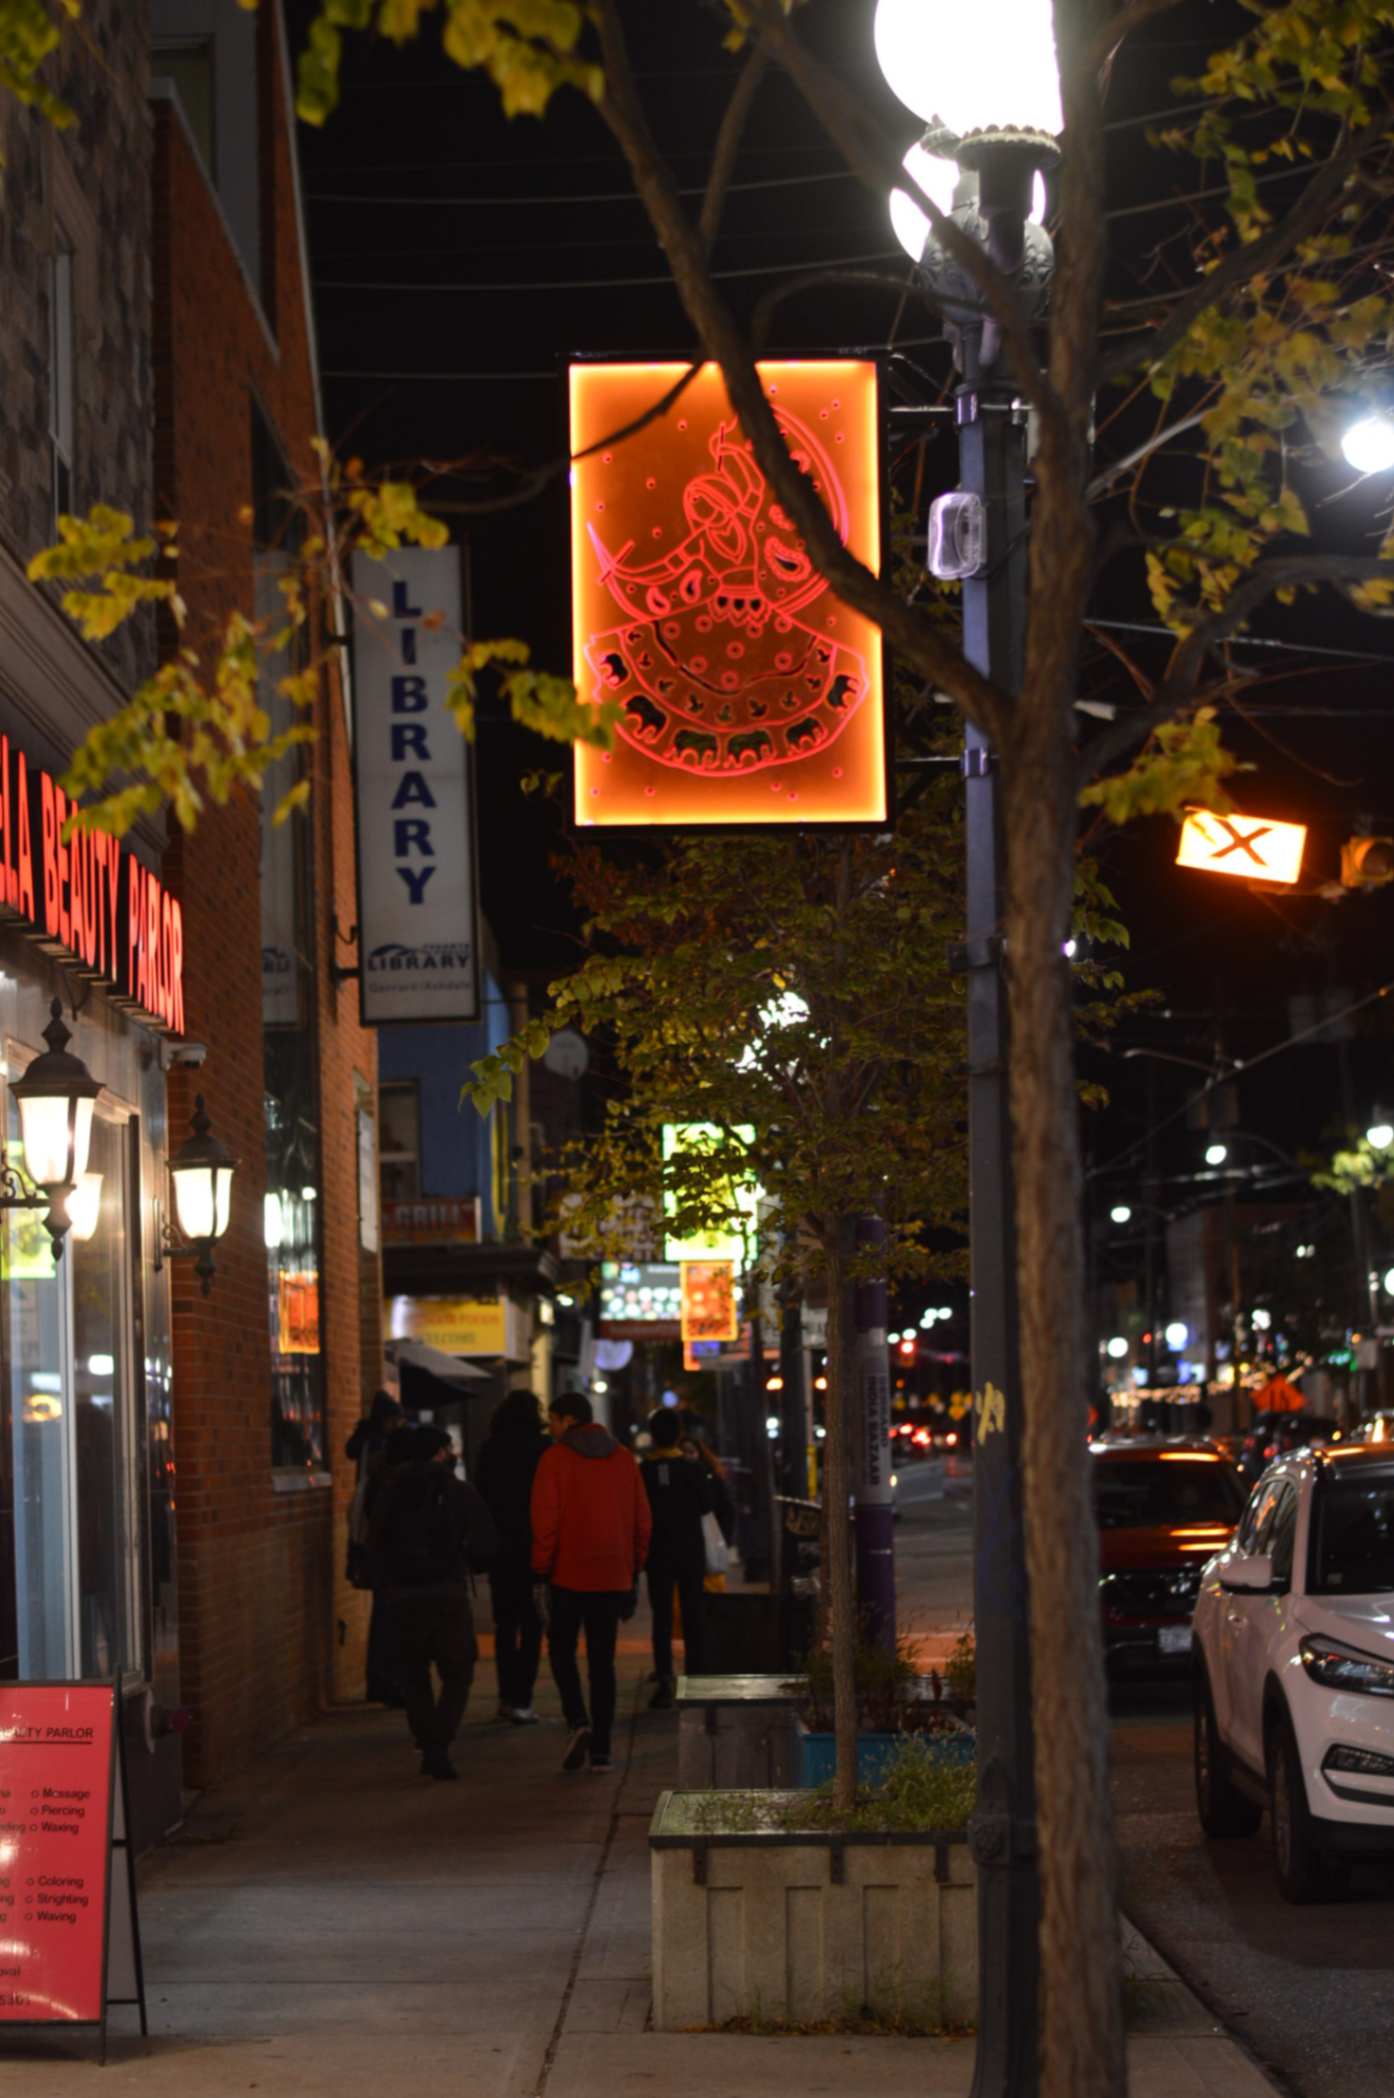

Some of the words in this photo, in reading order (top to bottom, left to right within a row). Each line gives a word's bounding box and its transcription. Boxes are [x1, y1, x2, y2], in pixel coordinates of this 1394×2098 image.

[391, 581, 437, 904] LIBRARY
[41, 771, 121, 983] BEAUTY
[129, 853, 185, 1036] PARLOR
[368, 954, 469, 971] LIBRARY
[46, 1727, 94, 1738] PARLOR
[41, 1804, 86, 1818] Piercing
[37, 1875, 85, 1889] Coloring
